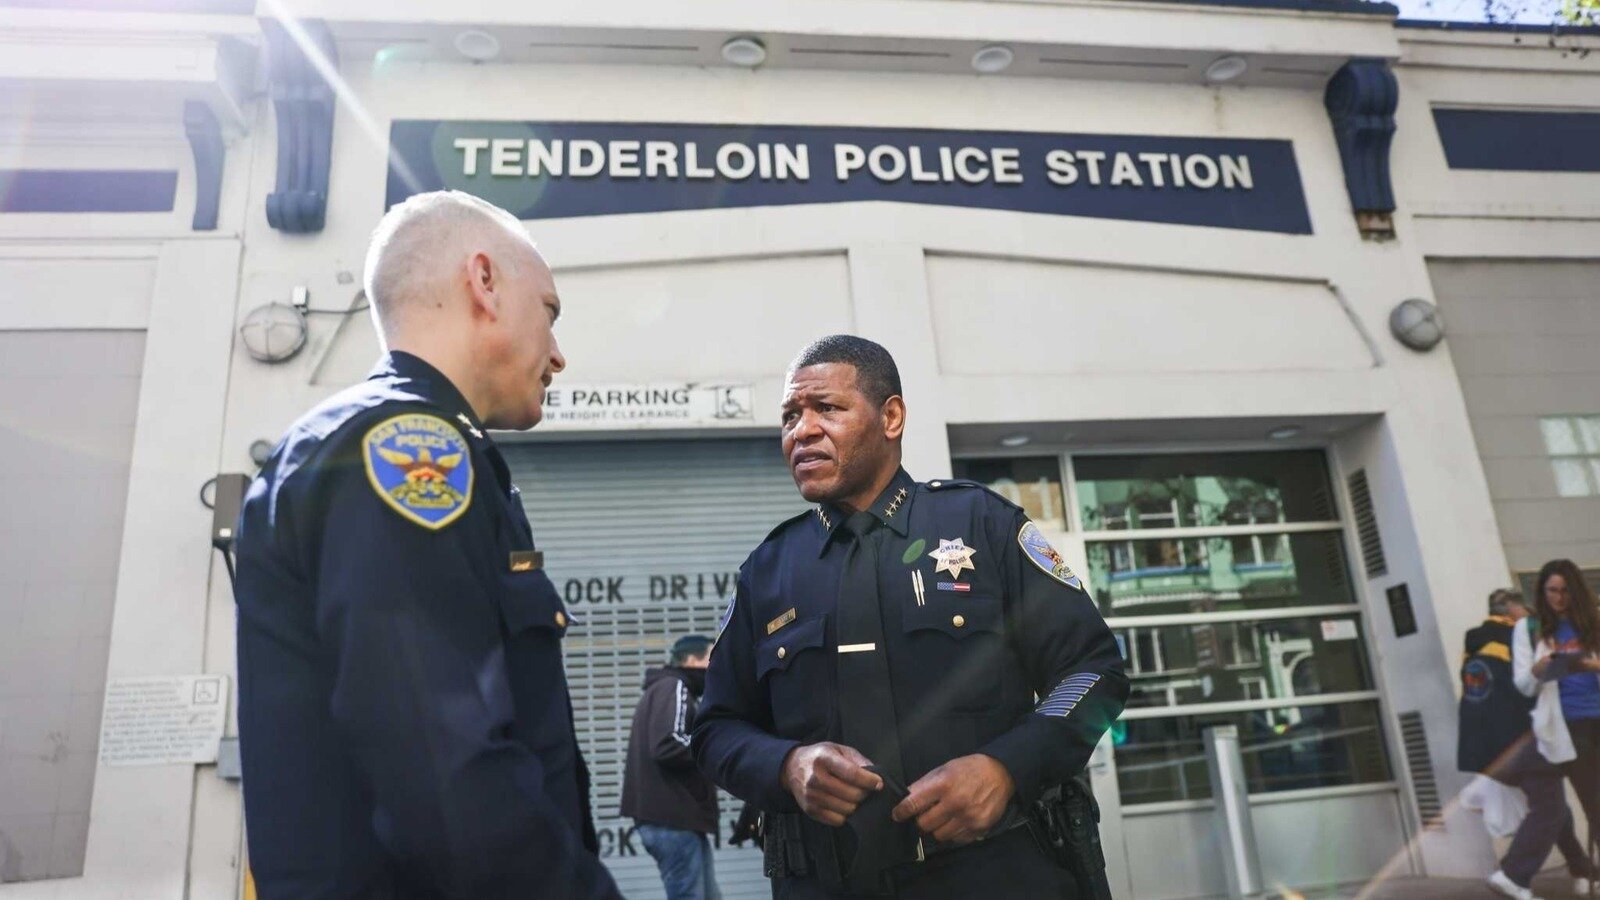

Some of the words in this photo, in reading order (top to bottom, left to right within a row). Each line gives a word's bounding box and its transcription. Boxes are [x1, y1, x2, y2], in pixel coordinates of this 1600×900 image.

[453, 137, 810, 180] TENDERLOIN
[834, 143, 1023, 184] POLICE
[1045, 149, 1254, 189] STATION
[573, 389, 690, 406] PARKING
[560, 411, 607, 420] HEIGHT
[612, 409, 690, 420] CLEARANCE
[939, 544, 966, 554] CHIEF
[565, 576, 625, 604] OCK
[650, 573, 739, 601] DRIV
